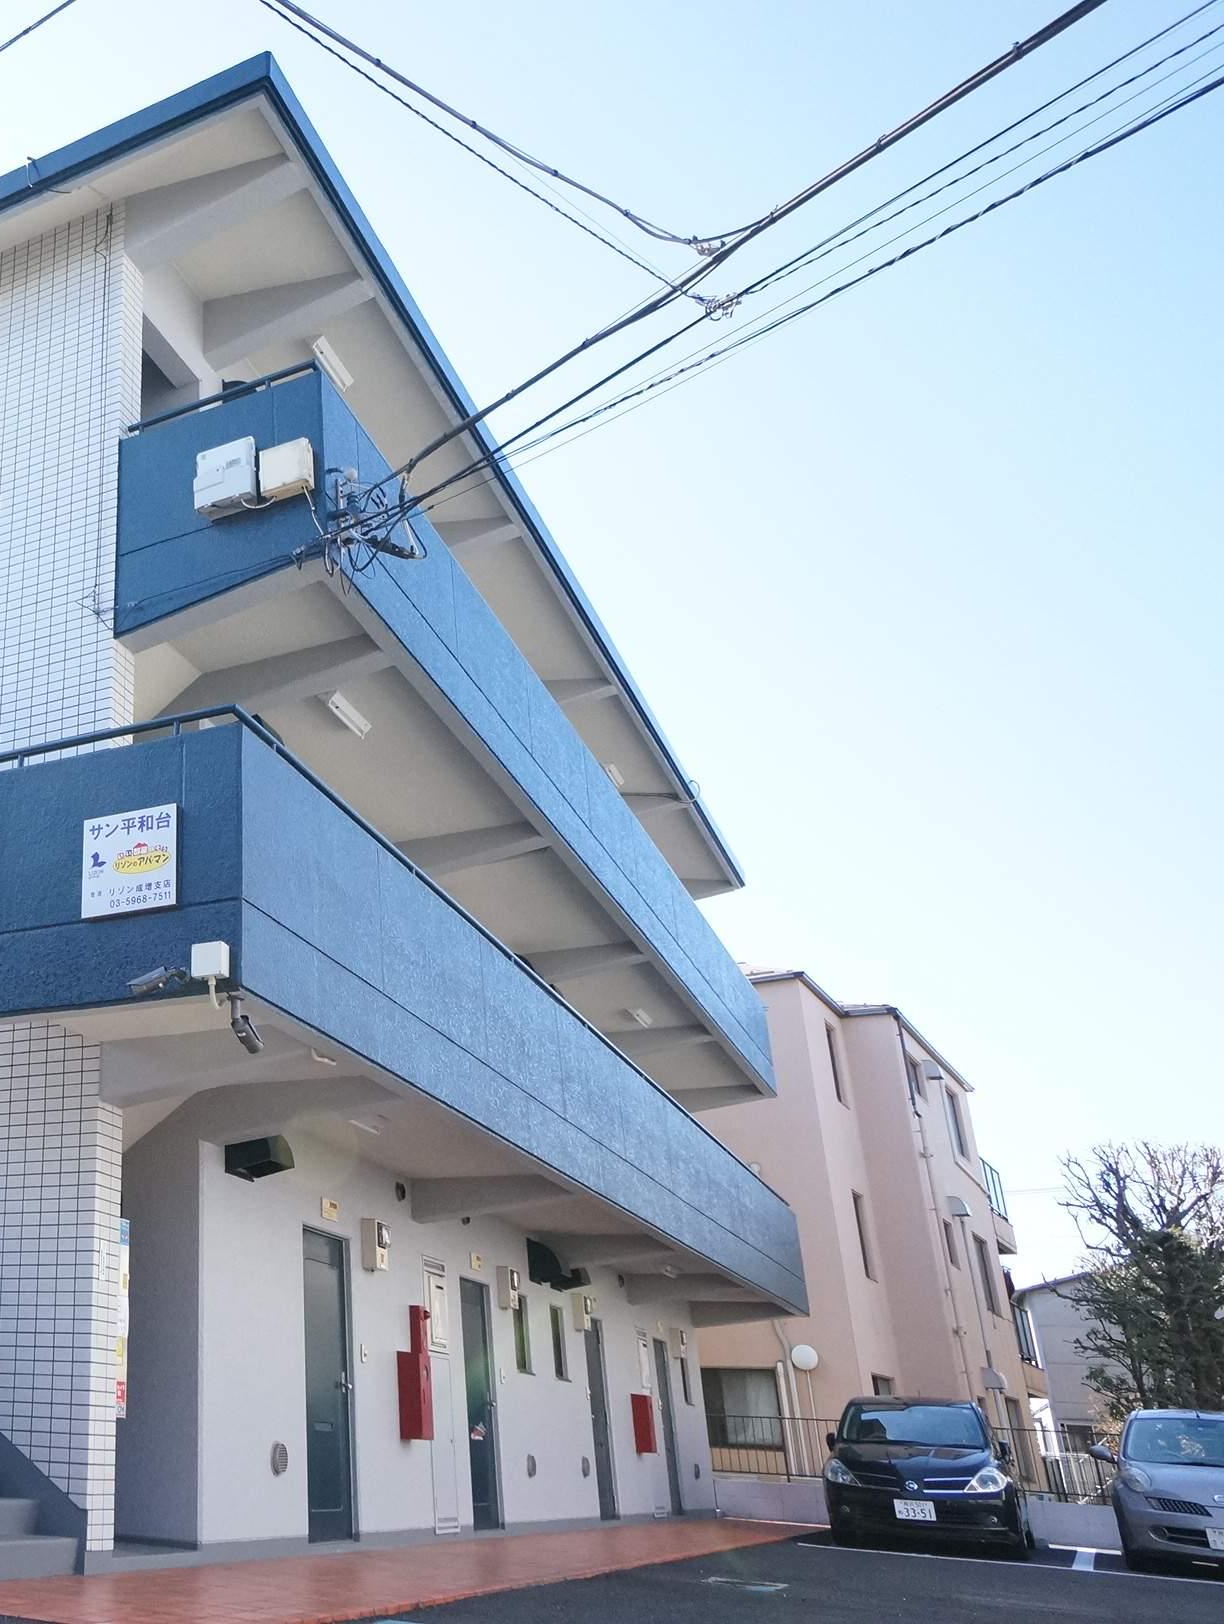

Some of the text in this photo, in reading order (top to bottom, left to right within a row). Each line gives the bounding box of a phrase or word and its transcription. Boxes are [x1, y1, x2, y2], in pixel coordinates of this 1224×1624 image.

[89, 812, 171, 840] サン平和台
[109, 880, 171, 897] リゾン成増支店
[109, 891, 171, 908] 03-5968-7511
